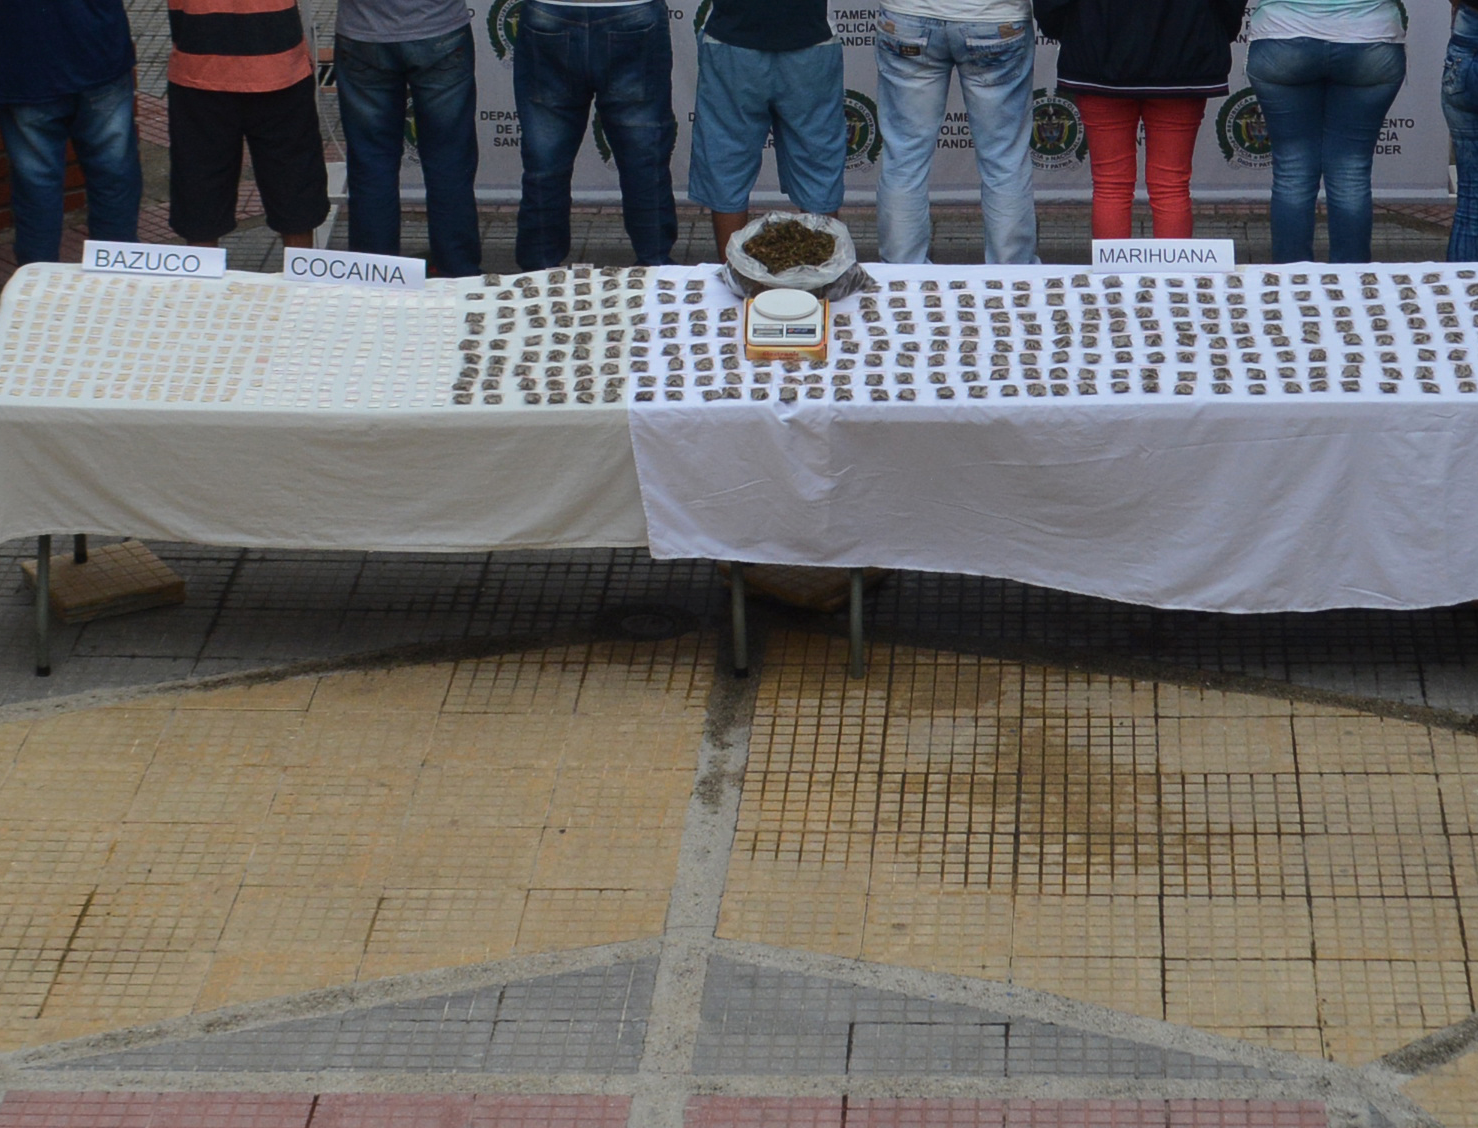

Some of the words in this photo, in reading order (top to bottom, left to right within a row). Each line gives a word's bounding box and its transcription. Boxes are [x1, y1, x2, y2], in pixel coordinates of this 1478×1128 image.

[95, 248, 202, 273] BAZUCO
[1099, 247, 1217, 264] MARIHUANA
[290, 257, 406, 285] COCAINA
